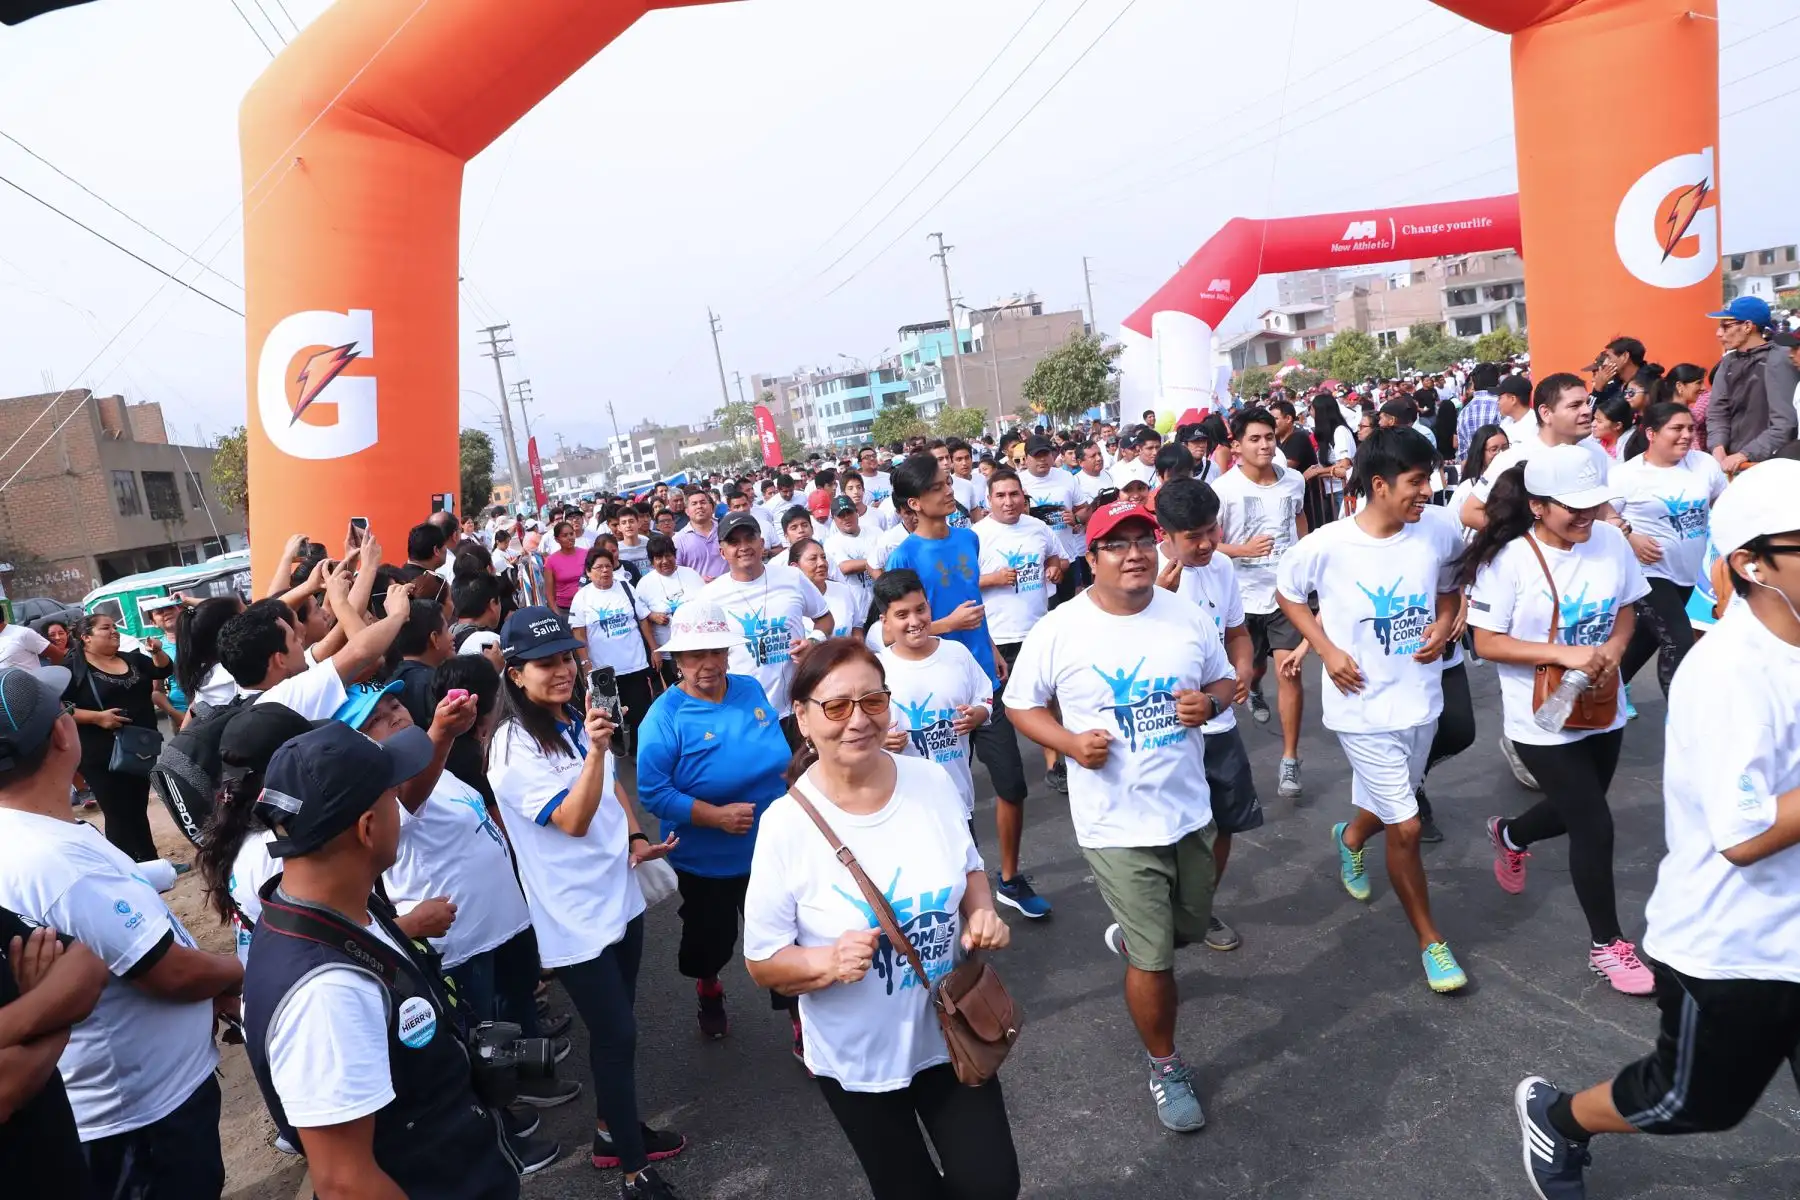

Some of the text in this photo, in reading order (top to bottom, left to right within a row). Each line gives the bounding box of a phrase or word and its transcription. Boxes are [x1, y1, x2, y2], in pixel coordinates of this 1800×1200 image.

[1402, 223, 1444, 236] Change
[1614, 146, 1718, 289] G
[1352, 239, 1390, 252] Athletic
[257, 308, 379, 460] G
[1389, 593, 1429, 617] 5K
[533, 623, 561, 638] Salud
[344, 940, 385, 973] Canon
